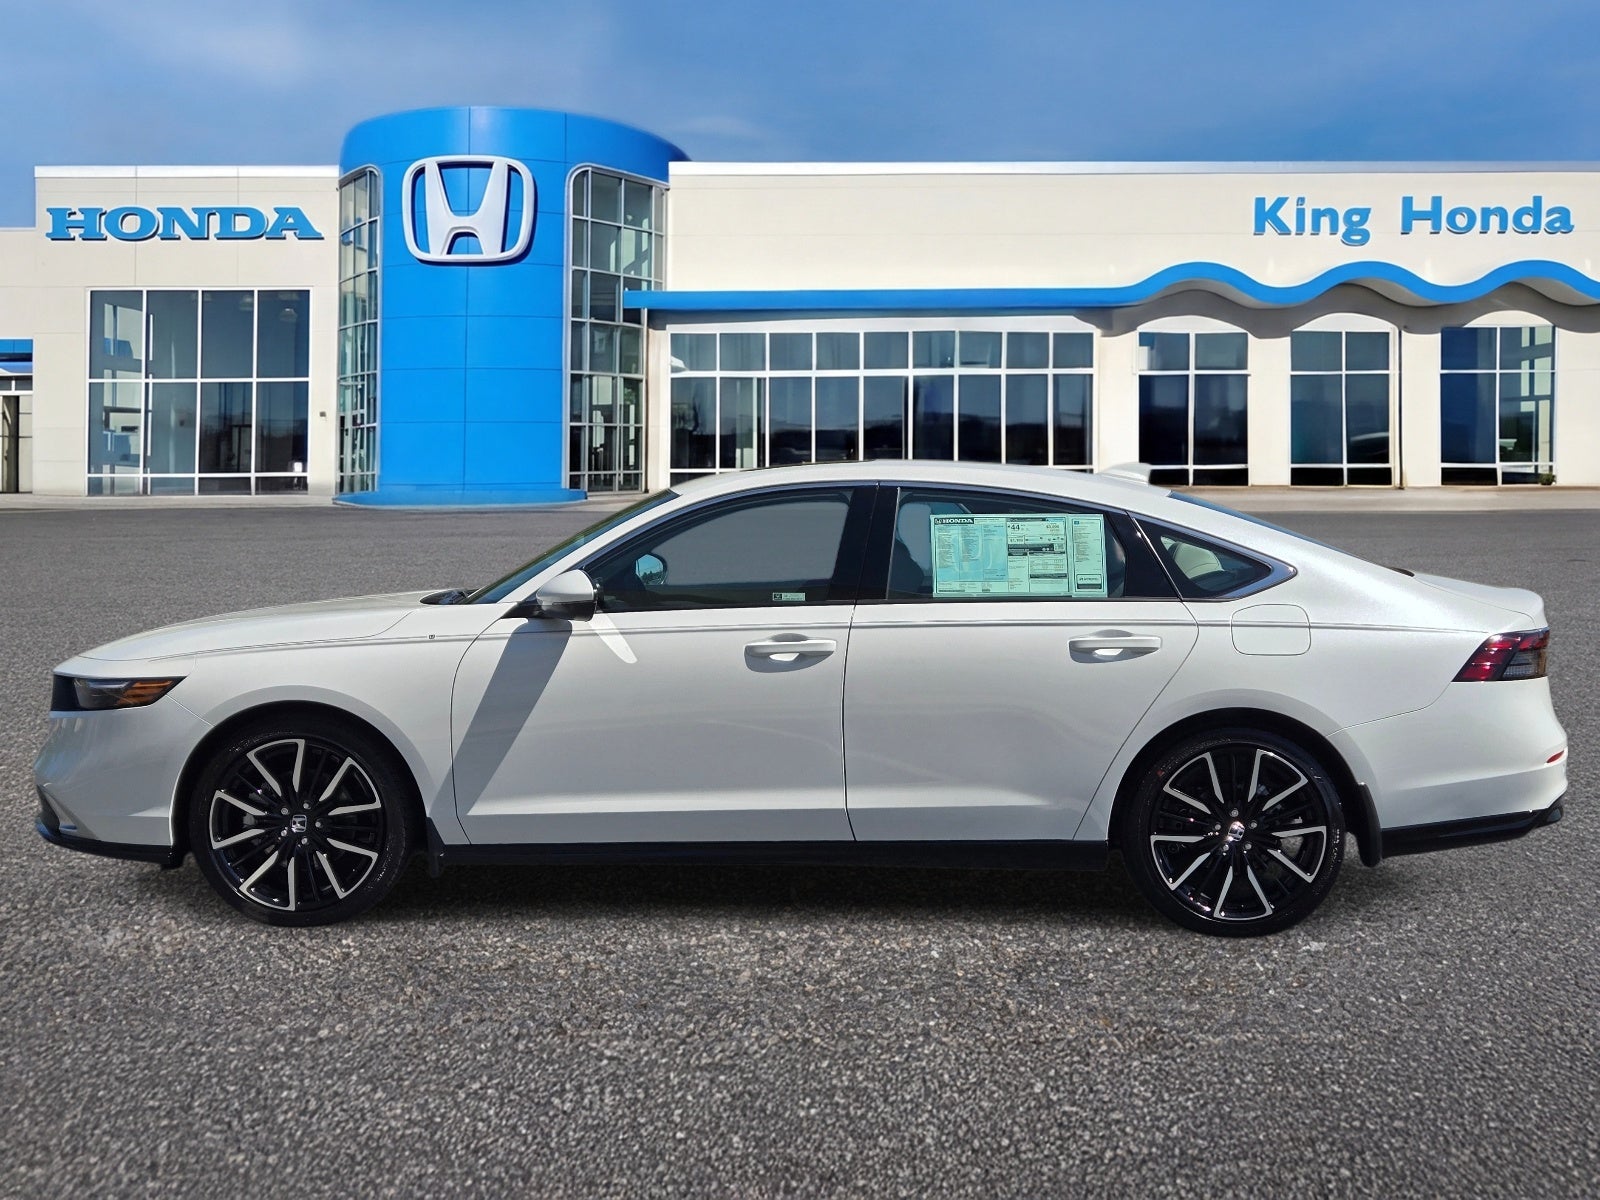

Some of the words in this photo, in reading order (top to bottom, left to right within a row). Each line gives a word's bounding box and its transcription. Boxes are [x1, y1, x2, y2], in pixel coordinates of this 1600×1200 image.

[45, 206, 325, 241] HONDA
[1253, 196, 1372, 246] King
[1400, 195, 1575, 234] Honda
